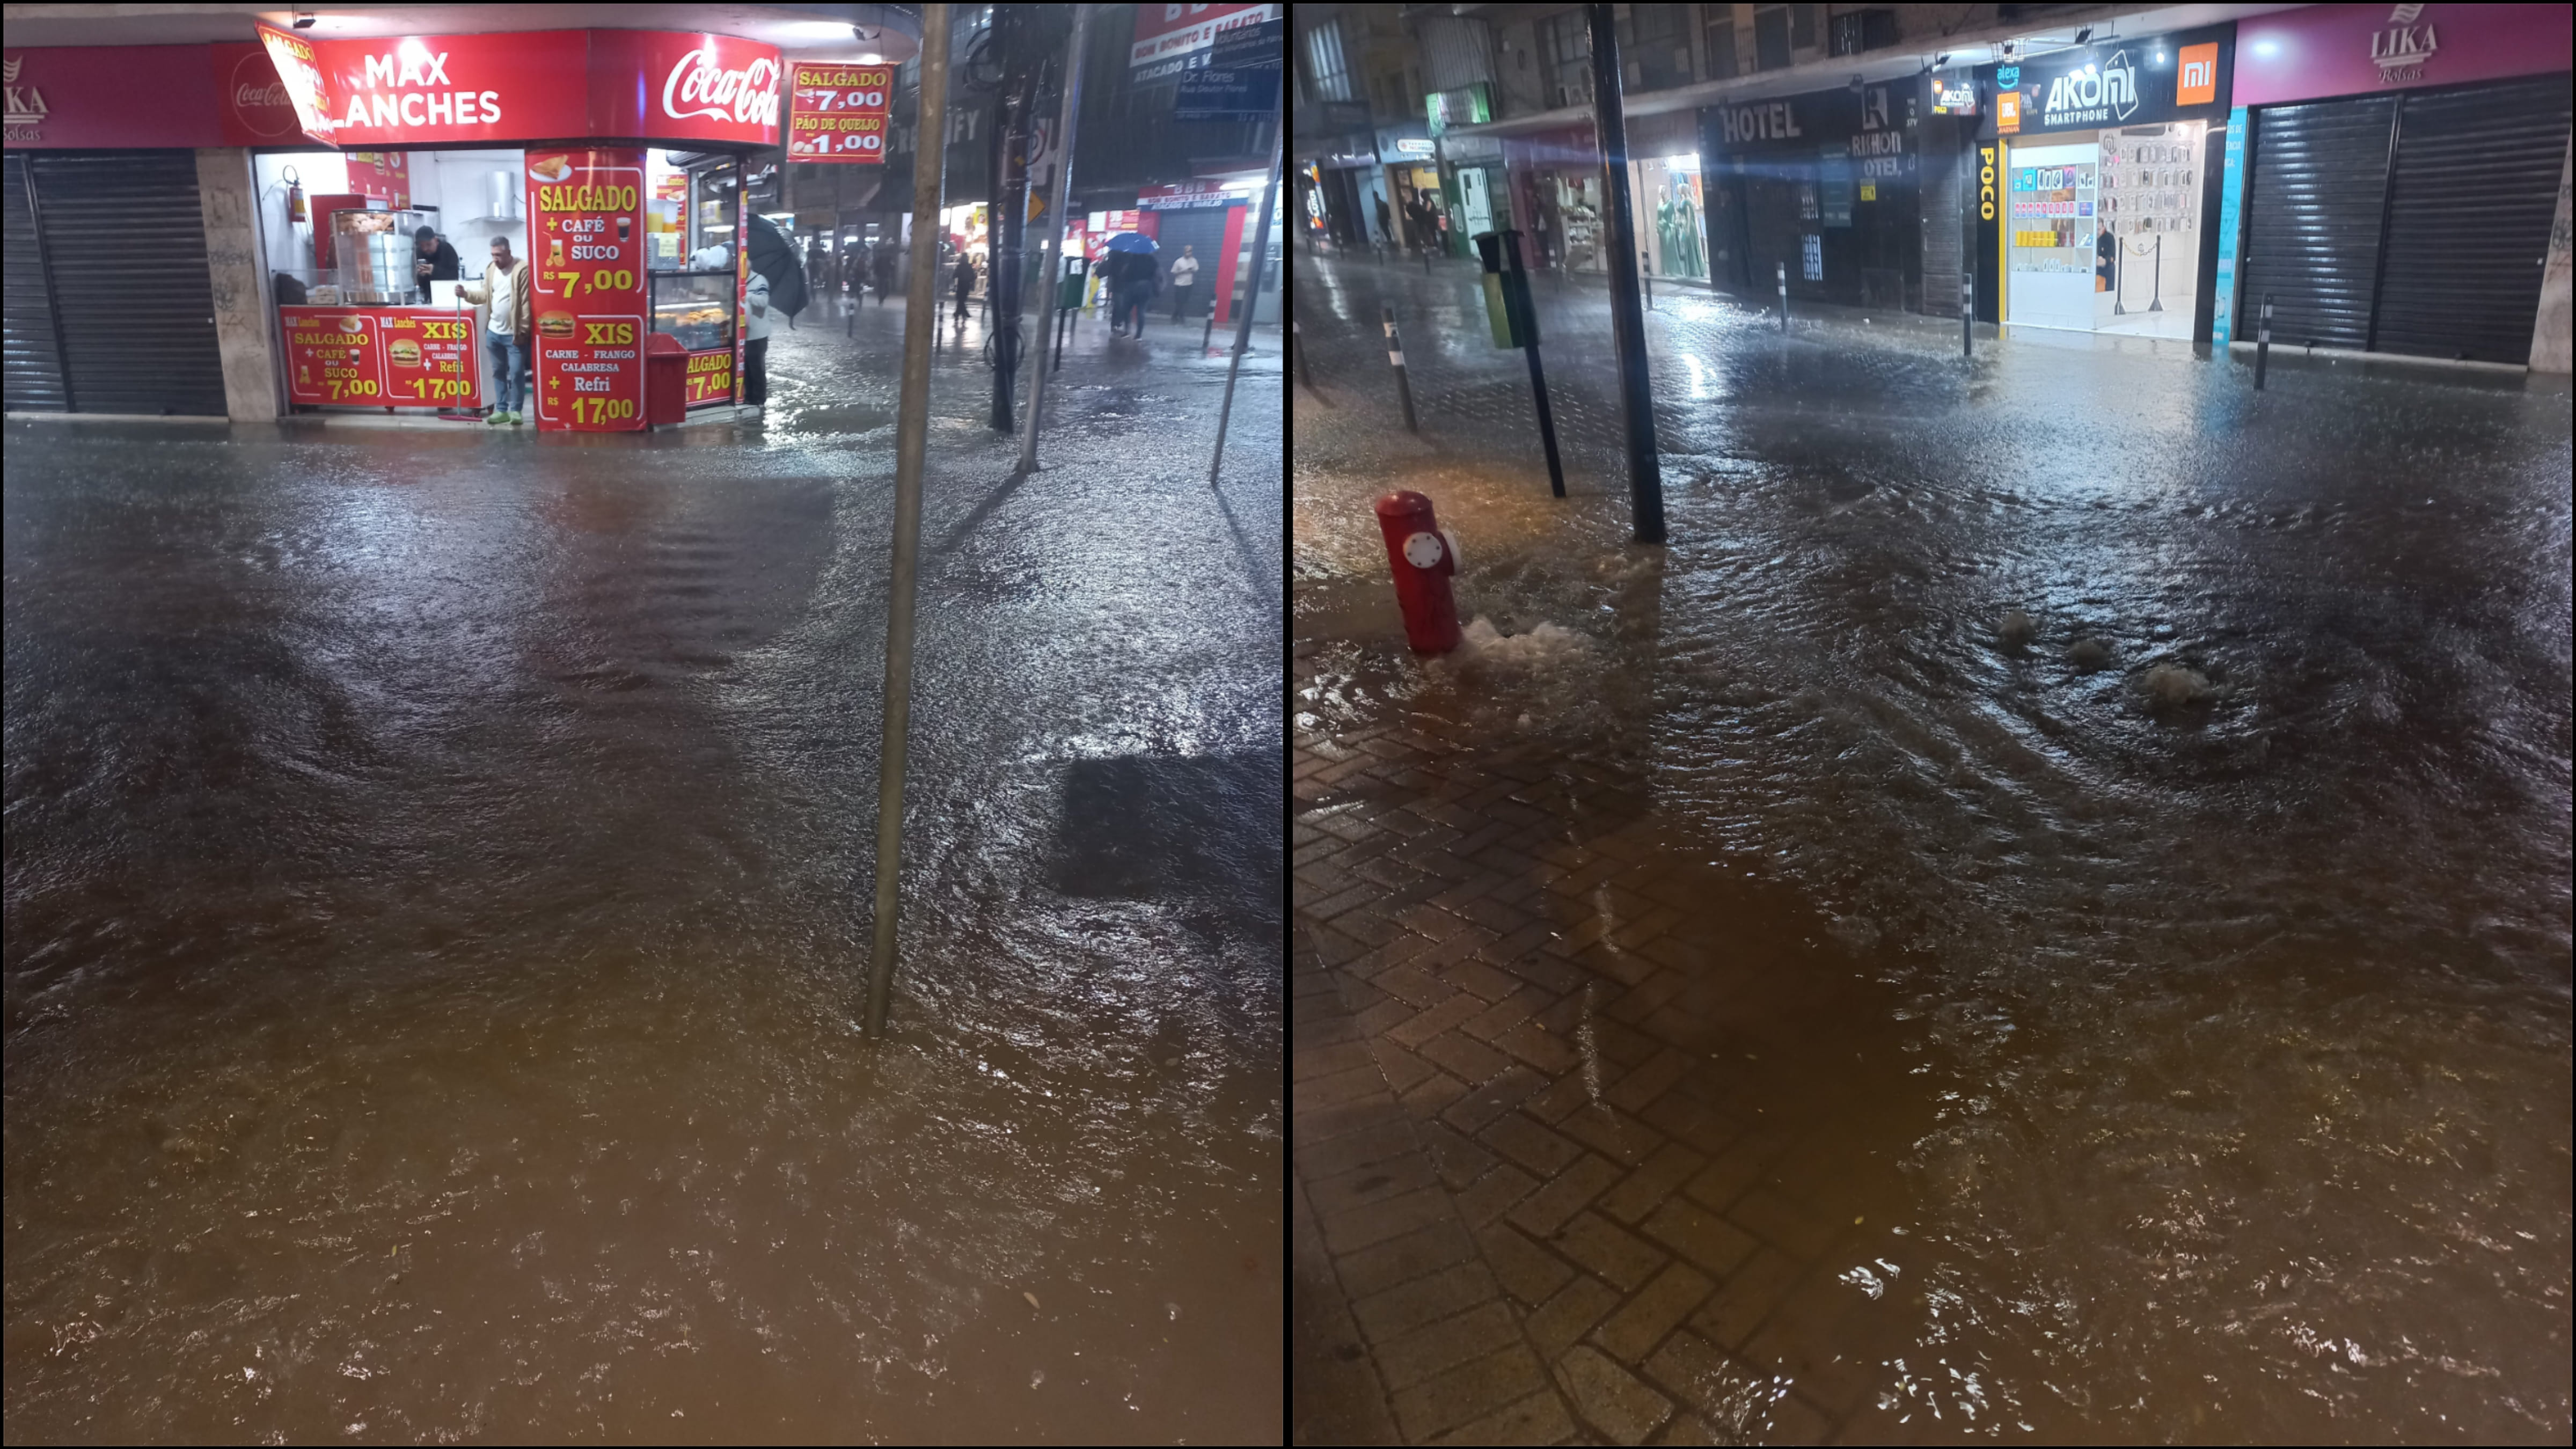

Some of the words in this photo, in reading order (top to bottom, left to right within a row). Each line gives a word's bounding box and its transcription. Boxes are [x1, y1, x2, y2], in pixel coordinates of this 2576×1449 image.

[1203, 26, 1211, 40] E
[2370, 23, 2438, 58] LIKA
[364, 52, 451, 88] MAX
[799, 71, 887, 87] SALGADO
[1134, 60, 1183, 83] ATACADO
[1188, 56, 1197, 69] E
[1202, 70, 1235, 82] Flores
[1997, 64, 2019, 79] alexa
[2379, 65, 2422, 83] Bolsas
[662, 49, 780, 127] Coca-Cola
[2045, 66, 2136, 113] AKOMI
[4, 86, 49, 113] KA
[815, 90, 884, 112] 7,00
[821, 118, 836, 131] DE
[839, 118, 881, 134] QUEIJO
[1718, 103, 1802, 143] HOTEL
[2045, 108, 2109, 126] SMARTPHONE
[811, 134, 881, 154] 1,00
[1852, 131, 1901, 156] RISHON
[1174, 182, 1206, 194] BBB
[1980, 148, 1995, 221] POCO
[540, 185, 636, 211] SALGADO
[562, 216, 605, 232] CAFÉ
[571, 245, 619, 260] SUCO
[558, 270, 633, 298] 7,00
[295, 333, 369, 345] SALGADO
[422, 322, 467, 339] XIS
[585, 324, 634, 345] XIS
[316, 348, 346, 358] CAFÉ
[545, 350, 579, 358] CARNE
[594, 350, 635, 359] FRANGO
[324, 368, 358, 378] SUCO
[561, 363, 620, 372] CALABRESA
[687, 354, 731, 374] ALGADO
[327, 379, 377, 400] 7,00
[413, 378, 471, 400] 17,00
[574, 377, 610, 391] Refri
[693, 372, 730, 400] 7,00
[572, 397, 633, 425] 17,00
